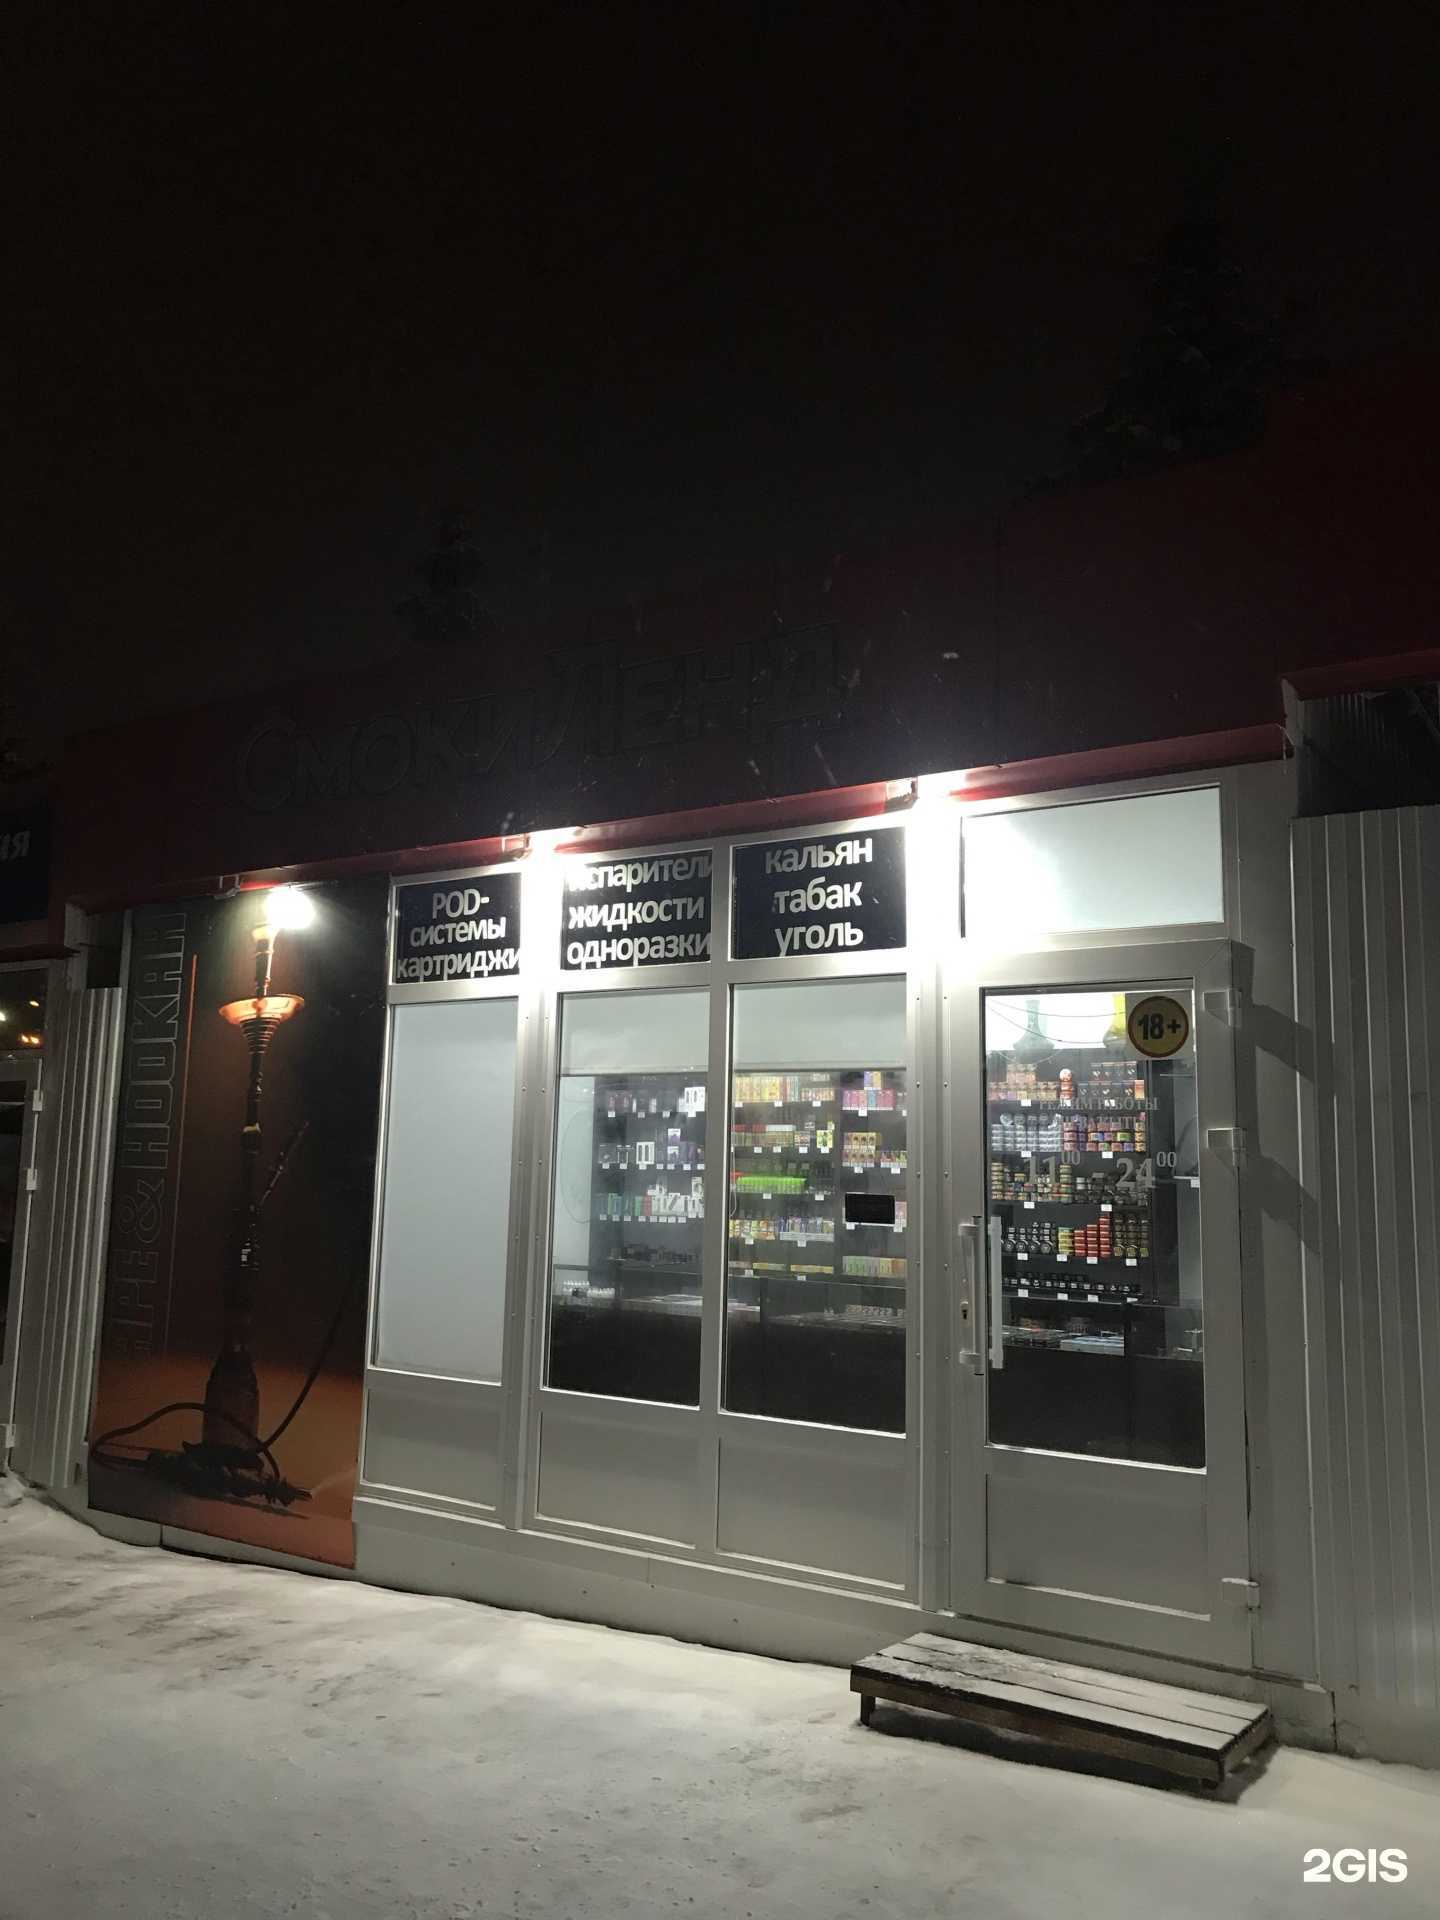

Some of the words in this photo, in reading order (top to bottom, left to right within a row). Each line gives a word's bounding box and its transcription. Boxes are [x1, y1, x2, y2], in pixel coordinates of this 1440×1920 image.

[765, 838, 873, 874] кальян
[567, 856, 712, 893] спарители
[432, 888, 490, 919] POD-
[774, 876, 863, 914] табак
[568, 896, 705, 932] жидкости
[410, 917, 506, 948] системы
[774, 922, 864, 957] уголь
[396, 948, 520, 981] картриджи
[567, 932, 712, 970] одноразки
[1137, 1013, 1182, 1040] 18+
